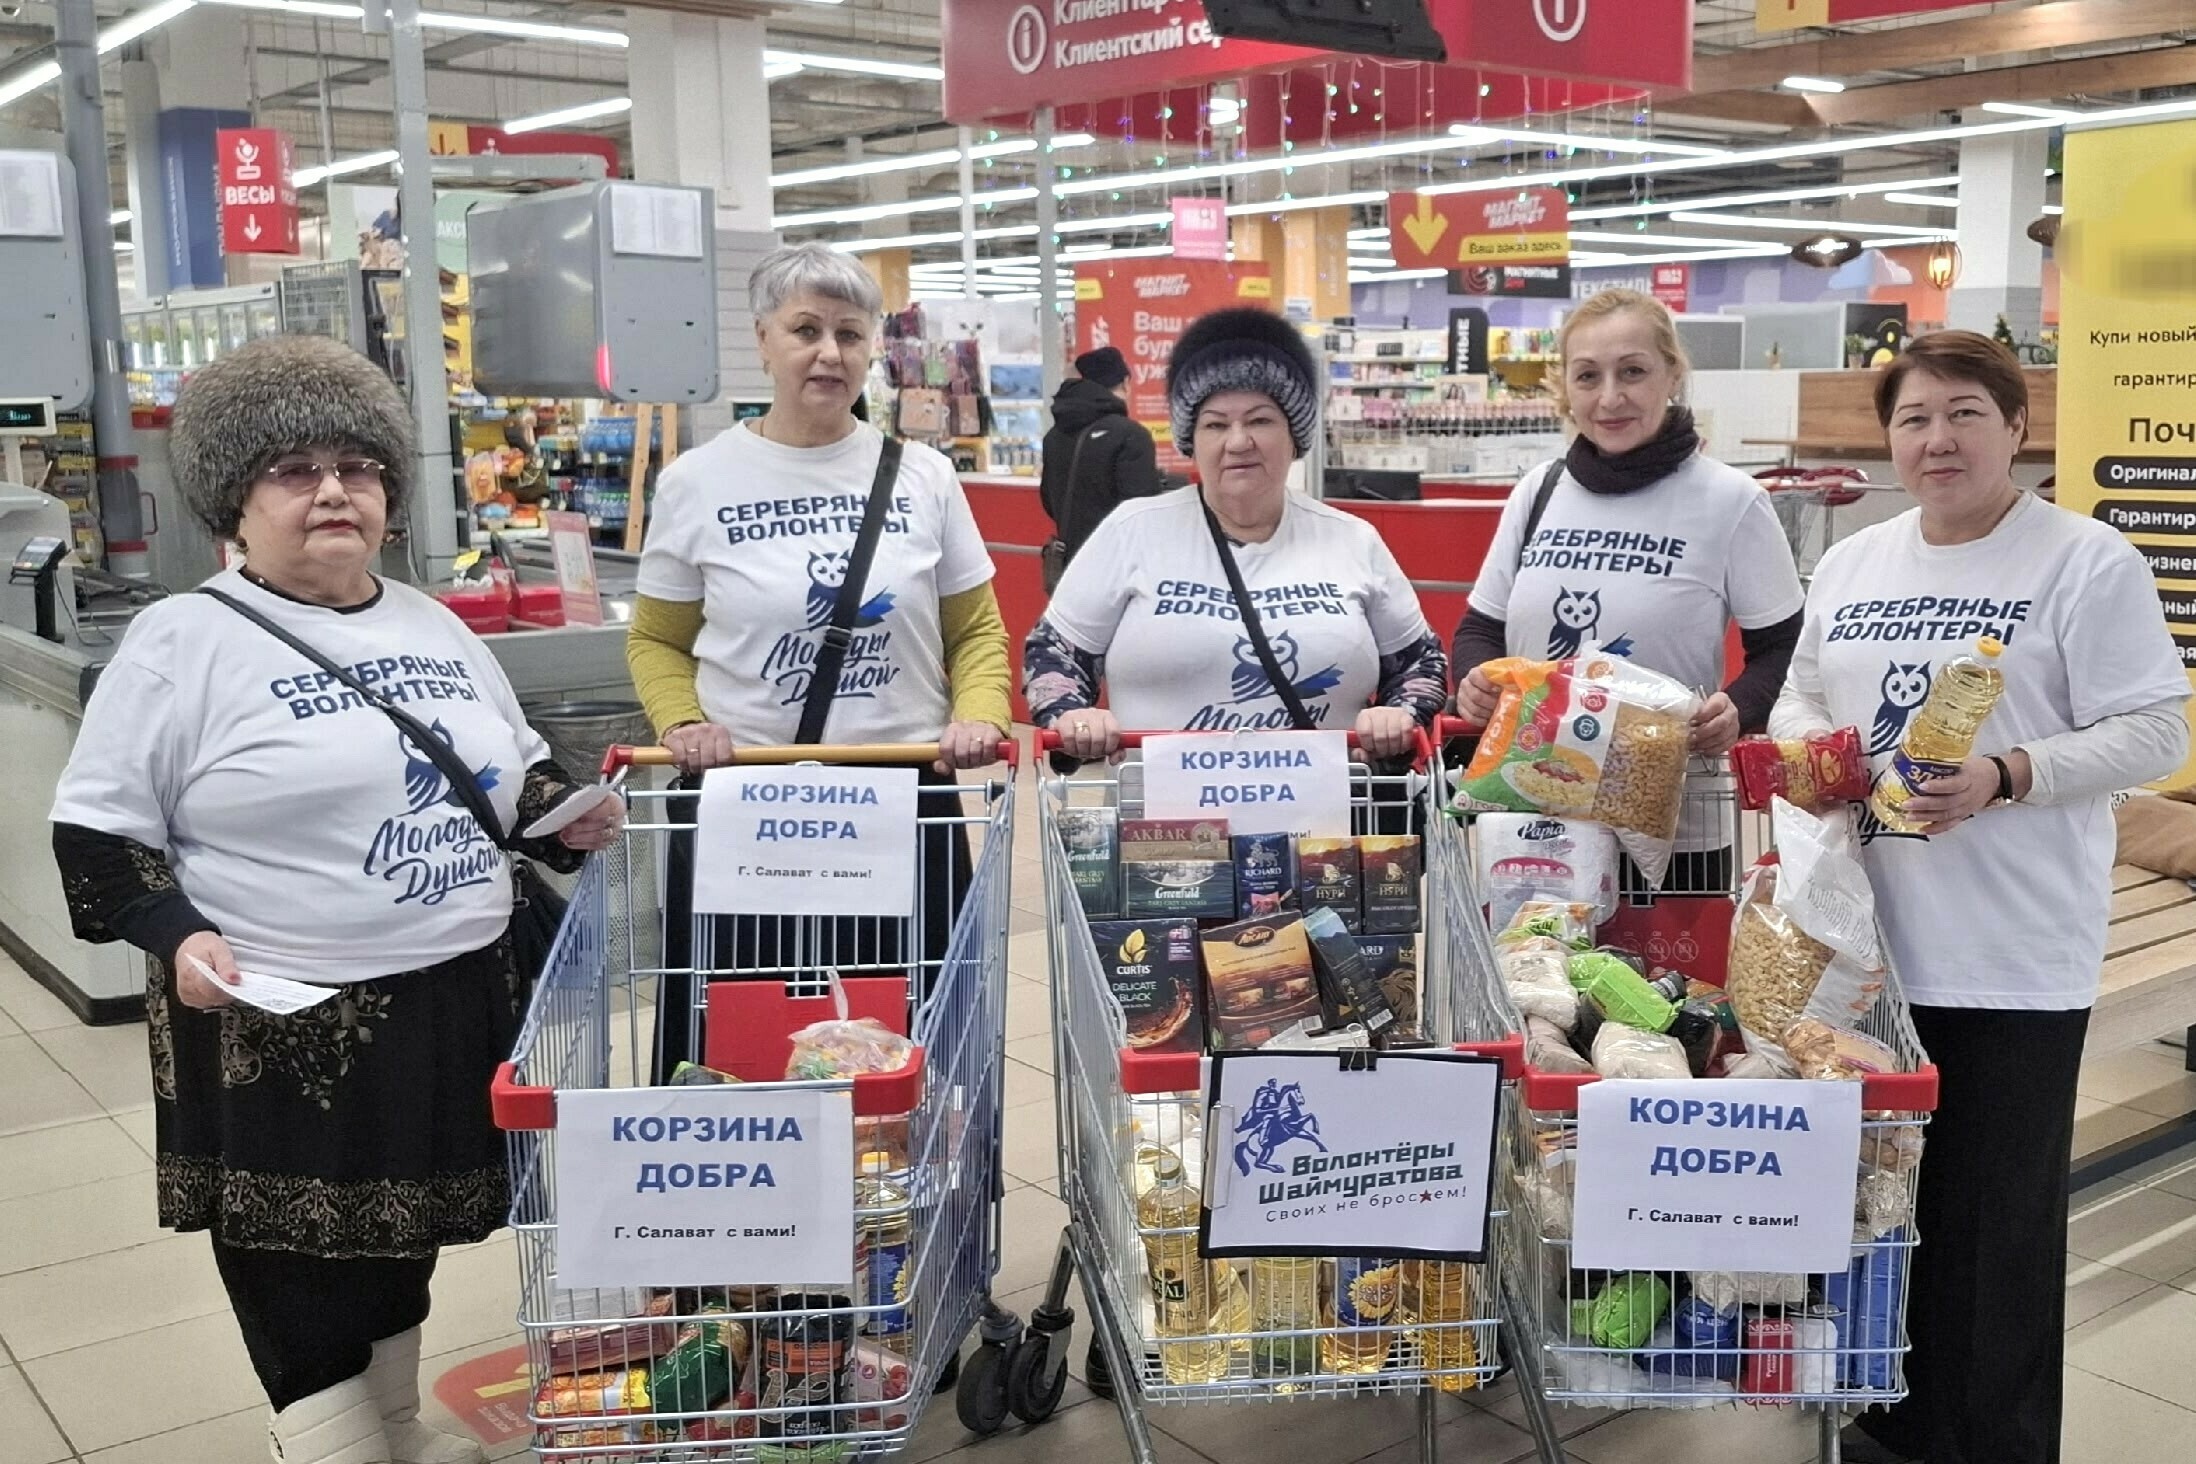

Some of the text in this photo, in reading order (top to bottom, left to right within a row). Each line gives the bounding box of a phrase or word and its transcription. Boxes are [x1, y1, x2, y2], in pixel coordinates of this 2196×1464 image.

[1054, 17, 1224, 68] Клиентский се
[225, 185, 276, 206] ВЕСЫ
[1469, 241, 1563, 254] Ваш заказ здесь
[1133, 311, 1182, 333] Ваш
[2090, 325, 2196, 348] Купи новый
[2129, 417, 2195, 443] Поч
[717, 494, 914, 525] СЕРЕБРЯНЕ
[727, 514, 911, 546] ВОЛОНТЕЫ
[1530, 528, 1687, 560] РЕБРЯНЫЕ
[1522, 548, 1673, 577] ОЛОНТЕРЫ
[1154, 599, 1348, 621] ВОЛОТЕРЫ
[1835, 596, 2032, 622] СЕРЕБРЯНЫЕ
[1826, 620, 2016, 646] ВОЛОНТЕРЫ
[760, 630, 892, 681] Моды
[776, 656, 900, 707] Дшой
[289, 681, 482, 720] ВОЛНТЕРЫ
[1181, 750, 1312, 770] КОРЗИНА
[741, 783, 879, 805] КОРЗИНА
[1199, 783, 1296, 807] ДОБРА
[756, 817, 858, 841] ДОБРА
[1131, 827, 1187, 841] AKBAR
[1520, 819, 1565, 840] Papia
[738, 866, 873, 879] Г. Салават с вами!
[1245, 867, 1282, 877] RICHARD
[1154, 886, 1201, 899] Greenfield
[1315, 886, 1346, 899] НУРИ
[1116, 965, 1151, 975] CURTIS
[1112, 981, 1157, 992] DELICATE
[1119, 992, 1152, 1002] BLACK
[1629, 1097, 1811, 1132] КОРЗИНА
[613, 1116, 803, 1142] КОРЗИНА
[1291, 1141, 1456, 1177] Волонтёры
[1650, 1146, 1783, 1177] ДОБРА
[636, 1162, 776, 1193] ДОБРА
[1259, 1164, 1464, 1205] Шаймуратова
[1266, 1203, 1327, 1222] Своих
[1336, 1200, 1359, 1211] не
[1628, 1207, 1800, 1228] Г. Салават с вами!
[614, 1224, 797, 1239] Г. Салават с вами!
